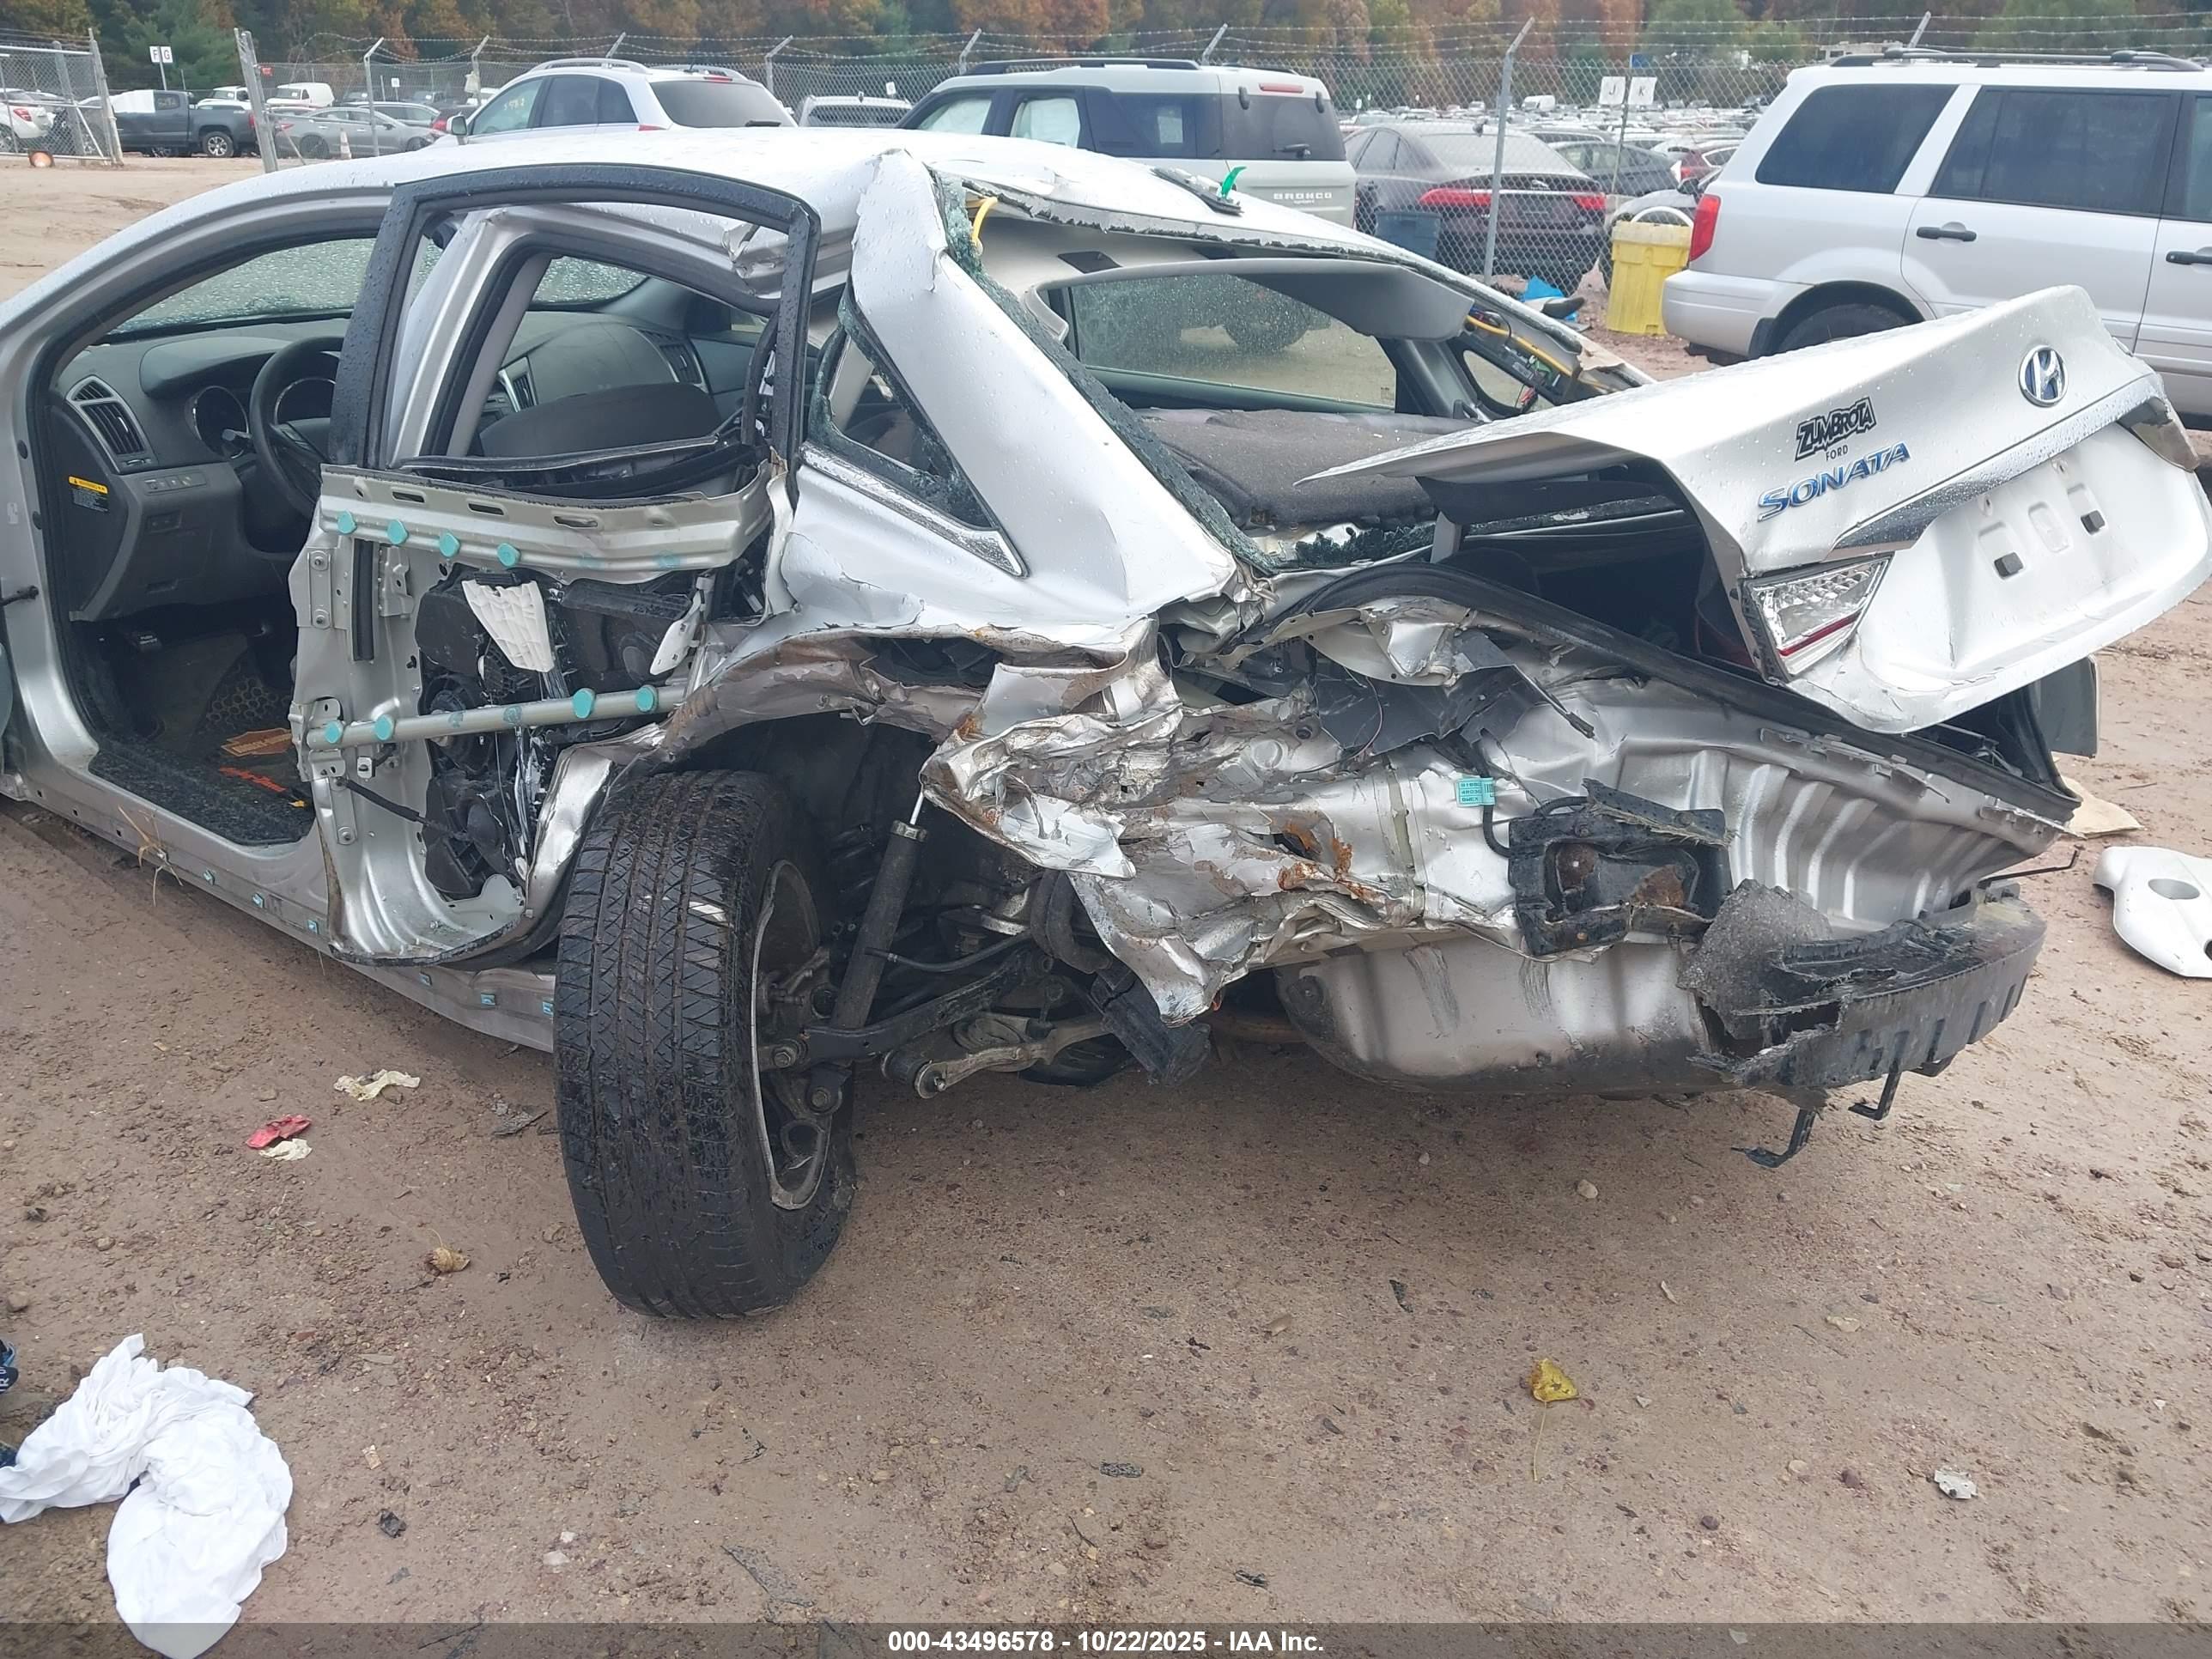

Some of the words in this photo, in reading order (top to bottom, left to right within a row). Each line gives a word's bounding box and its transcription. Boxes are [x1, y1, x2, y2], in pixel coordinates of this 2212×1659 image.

[163, 49, 170, 60] G
[1608, 84, 1616, 95] J
[1638, 85, 1646, 96] K
[1796, 397, 1876, 460] ZUMBROTA
[1826, 445, 1849, 461] FORD
[1758, 441, 1911, 521] SONATA
